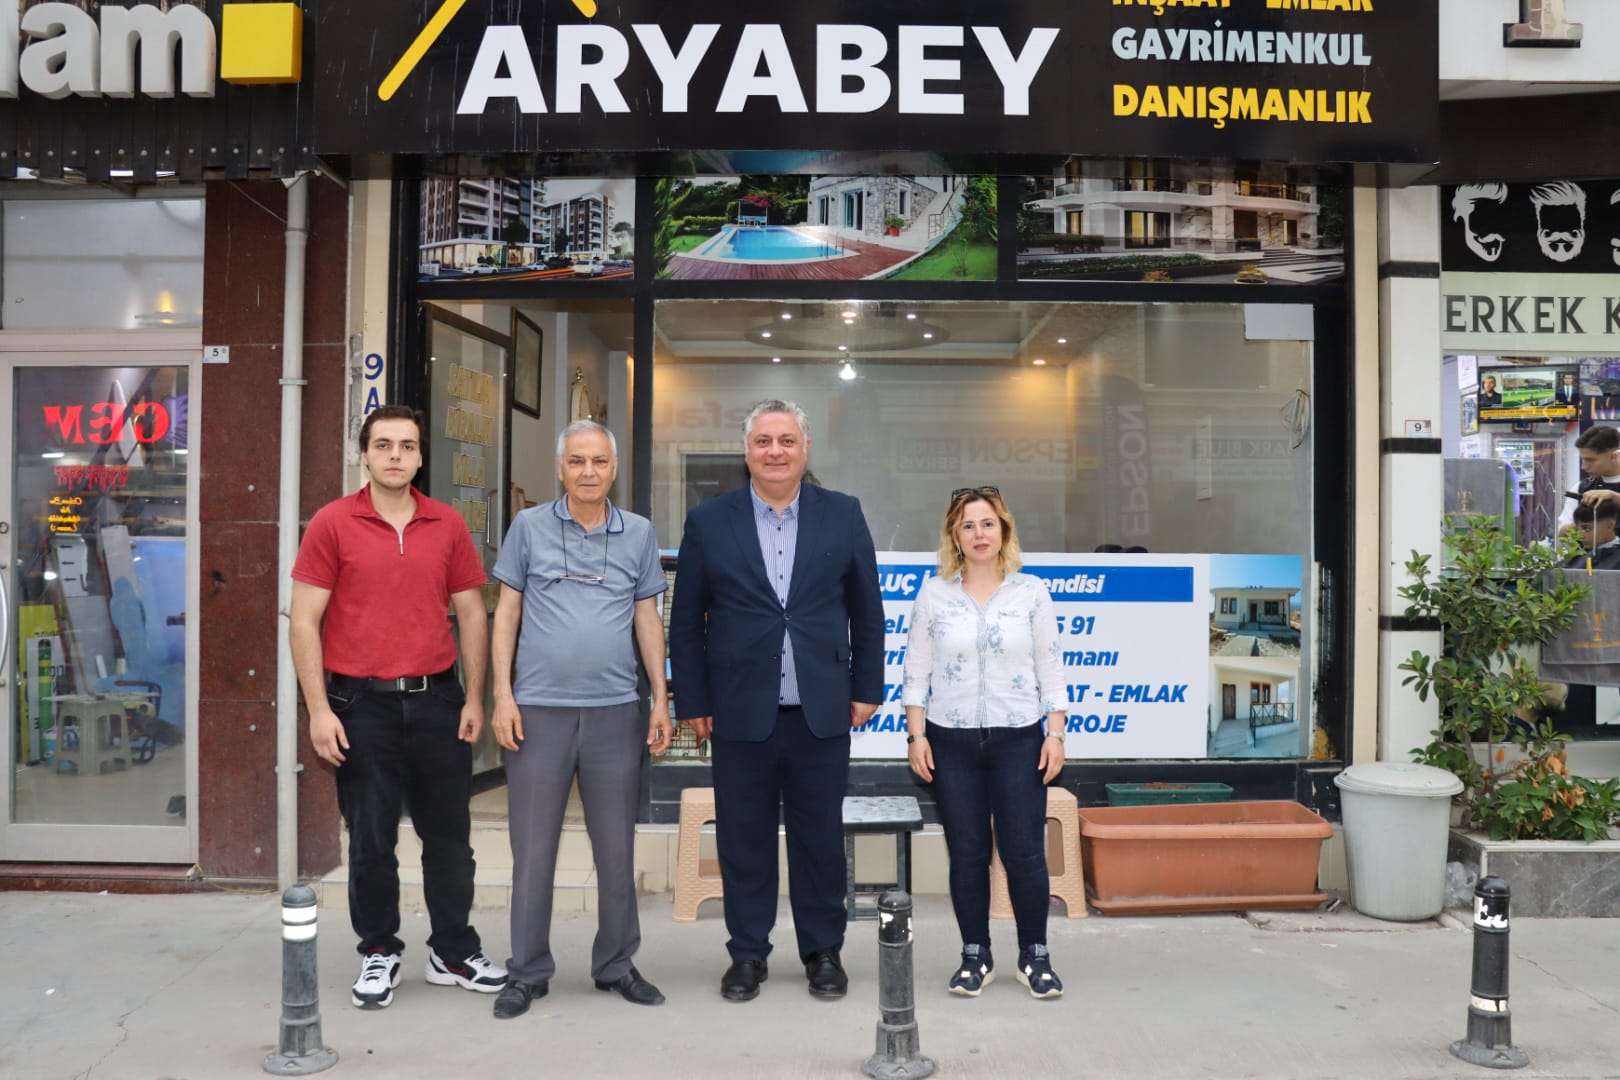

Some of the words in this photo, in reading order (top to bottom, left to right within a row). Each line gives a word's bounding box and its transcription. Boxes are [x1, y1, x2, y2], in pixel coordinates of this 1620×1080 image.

[1111, 20, 1372, 65] GAYRİMENKUL
[455, 24, 1060, 116] ARYABEY
[1113, 84, 1373, 129] DANIŞMANLIK
[1443, 295, 1586, 334] ERKEK
[365, 353, 384, 380] 9
[1414, 422, 1422, 432] 9
[1070, 616, 1095, 635] 91
[1108, 684, 1188, 702] EMLAK
[852, 714, 908, 732] MAR
[1064, 714, 1128, 733] ROJE
